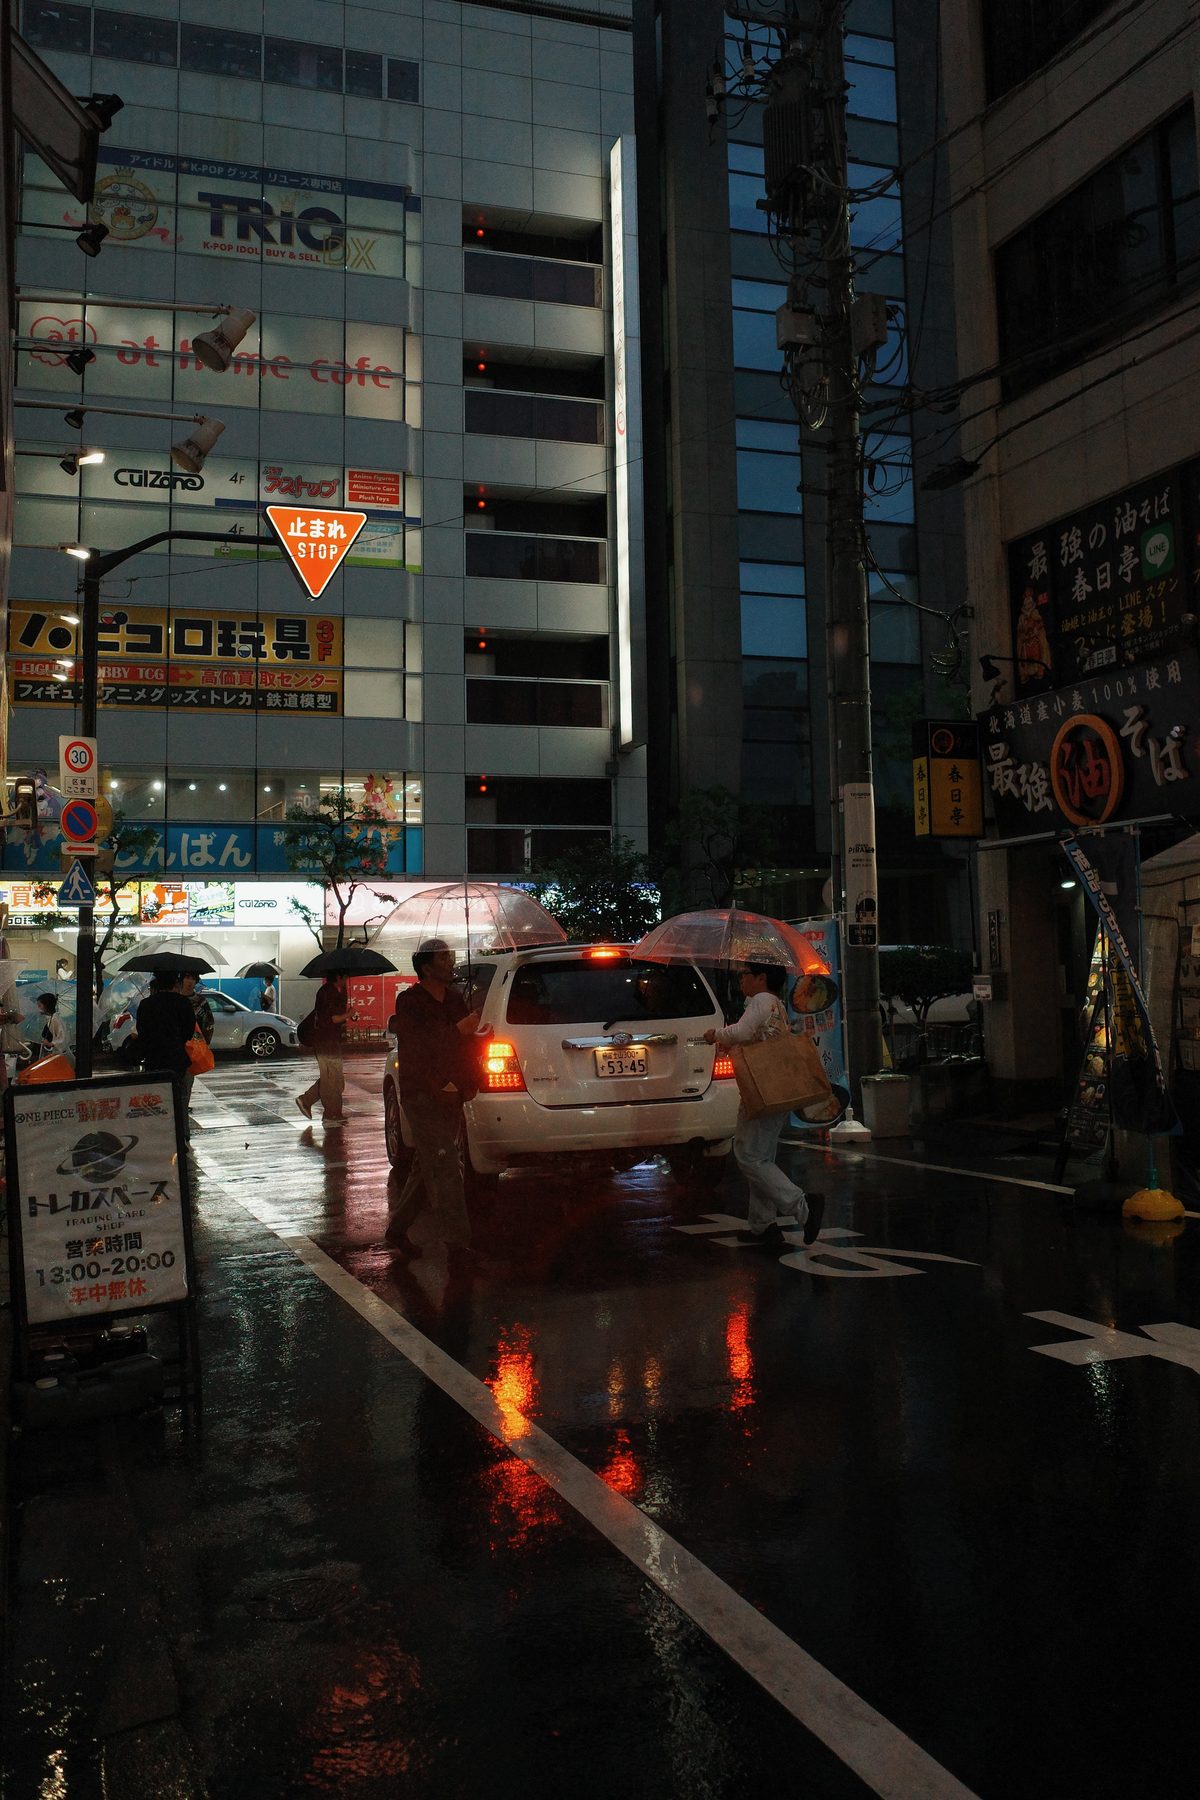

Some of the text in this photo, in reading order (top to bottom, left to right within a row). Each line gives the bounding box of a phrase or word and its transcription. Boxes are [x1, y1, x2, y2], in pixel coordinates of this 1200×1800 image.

[130, 153, 174, 170] アイドル
[190, 162, 224, 176] K-POP
[227, 167, 260, 181] グッズ
[203, 241, 321, 263] K-POP IDOL BUY & SELL
[117, 334, 394, 390] at hme cafe
[229, 472, 245, 485] 4F
[352, 483, 381, 492] Miniature
[359, 494, 390, 503] Plush Toys
[287, 516, 348, 540] 止まれ
[1027, 486, 1171, 582] 最強の油そば
[297, 542, 339, 561] STOP
[1148, 541, 1167, 557] LINE
[1071, 543, 1141, 604] 春日亭
[136, 666, 165, 682] TCG
[201, 667, 339, 690] 高価買取センター
[18, 683, 333, 709] フィギュアニメグッズ・トレカ・鉄道模型
[71, 750, 89, 765] 30
[66, 786, 93, 795] ここまで
[947, 764, 965, 826] 春日亭
[607, 1059, 645, 1075] 53-45
[43, 1108, 75, 1121] PIECE
[65, 1209, 146, 1228] TRADING CARD
[96, 1221, 125, 1232] SHOP
[65, 1231, 143, 1260] 営業時間
[36, 1250, 176, 1287] 13:00-20:00
[69, 1277, 148, 1305] 年中無休
